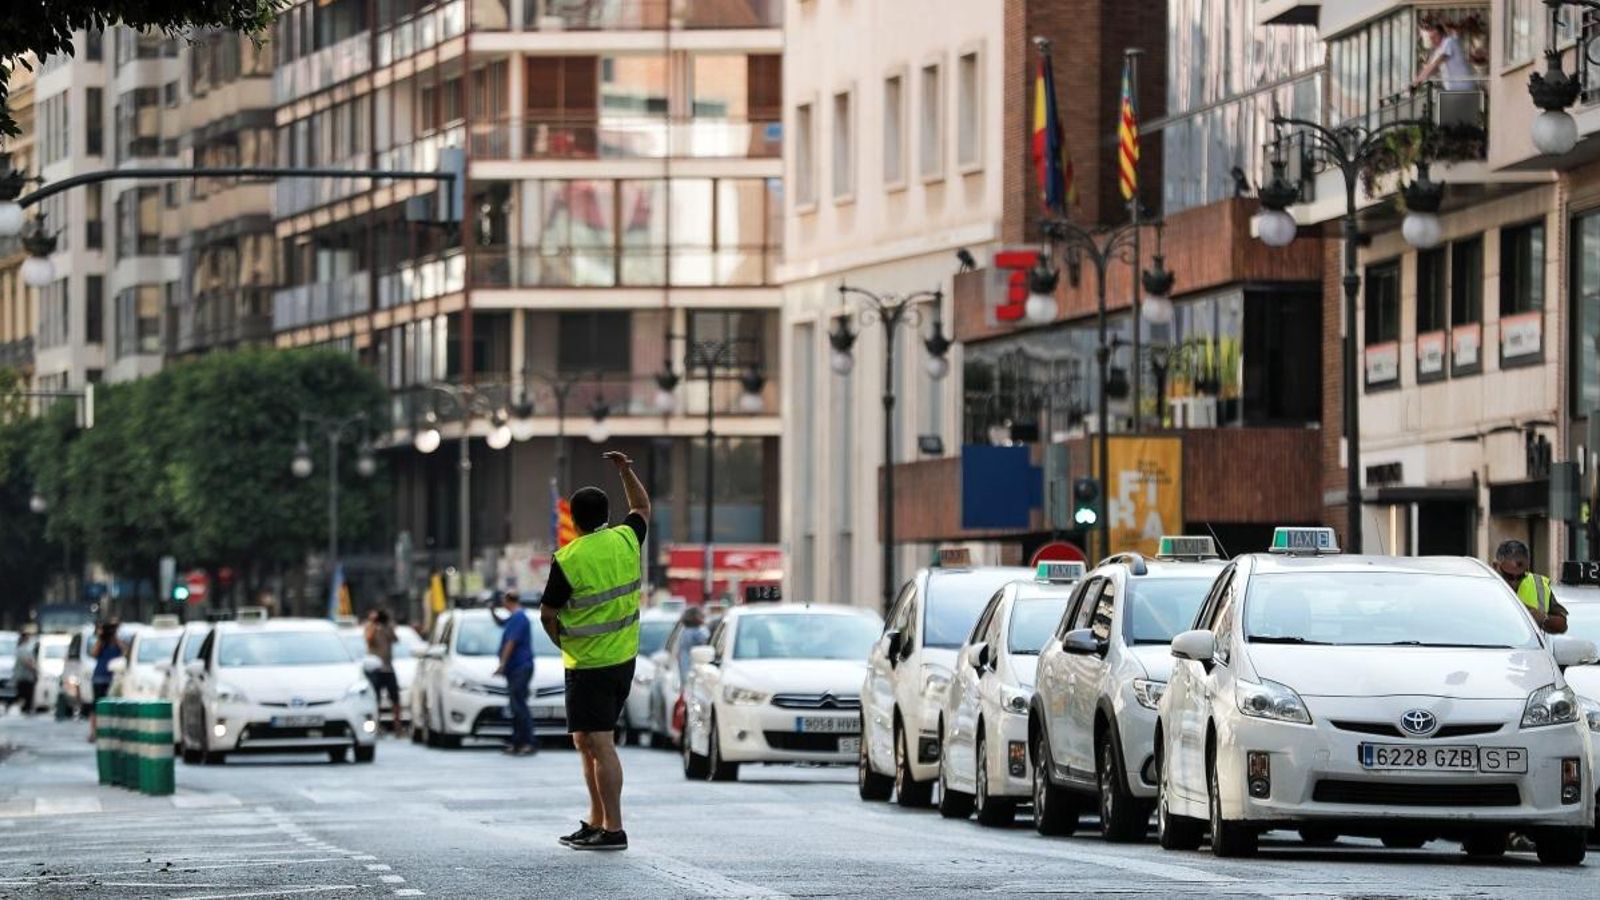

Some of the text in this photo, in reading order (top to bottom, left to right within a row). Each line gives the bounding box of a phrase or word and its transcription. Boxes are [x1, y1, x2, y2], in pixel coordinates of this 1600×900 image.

[1288, 530, 1316, 548] TAXI
[1049, 564, 1072, 578] TAXI
[1376, 748, 1521, 769] 6228 GZB SP
